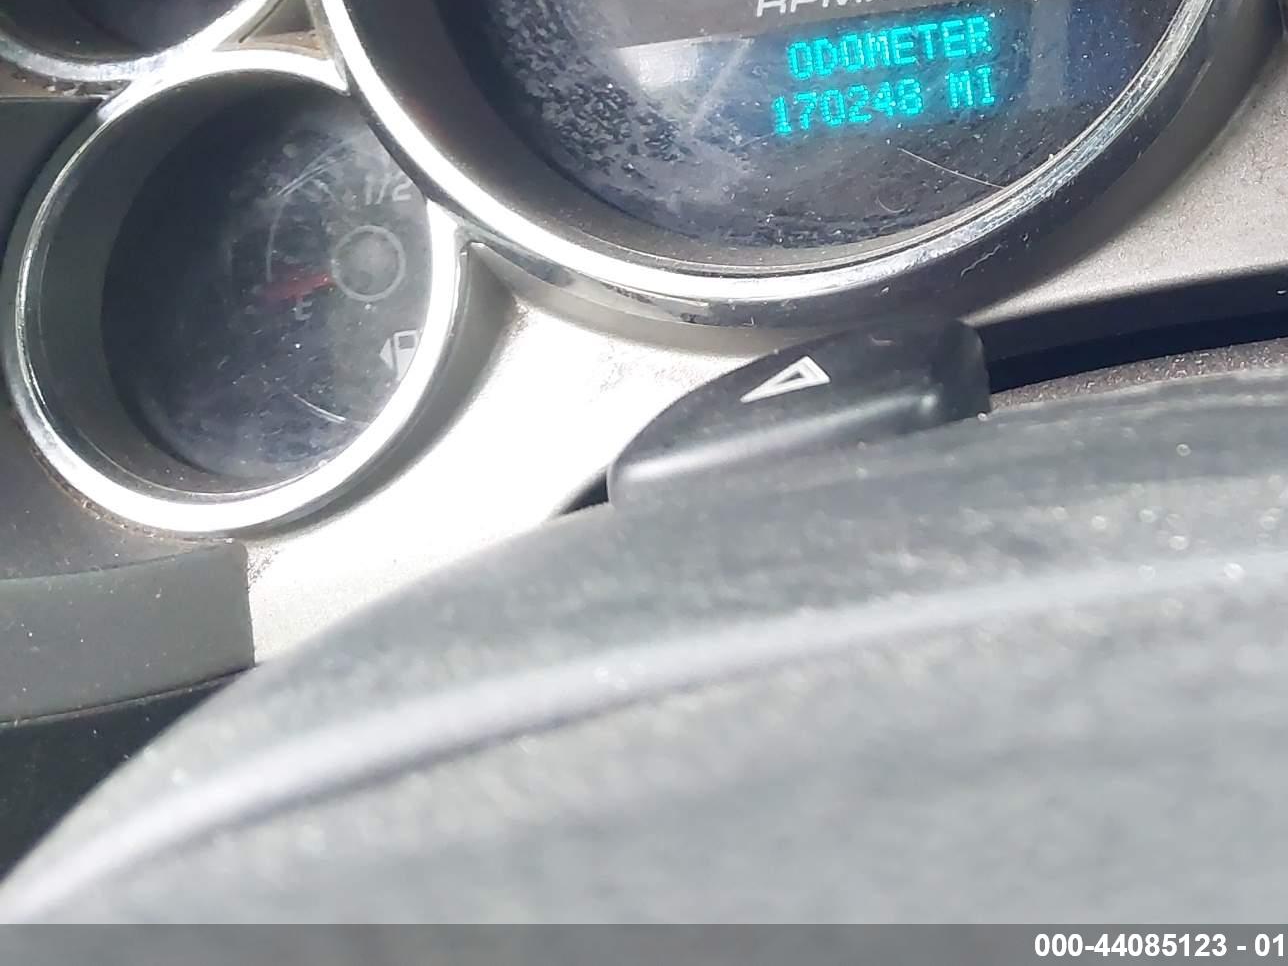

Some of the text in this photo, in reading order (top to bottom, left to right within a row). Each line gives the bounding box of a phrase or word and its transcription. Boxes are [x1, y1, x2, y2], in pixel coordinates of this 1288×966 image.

[788, 16, 993, 78] ODOMETER
[773, 67, 995, 136] 170248 MI
